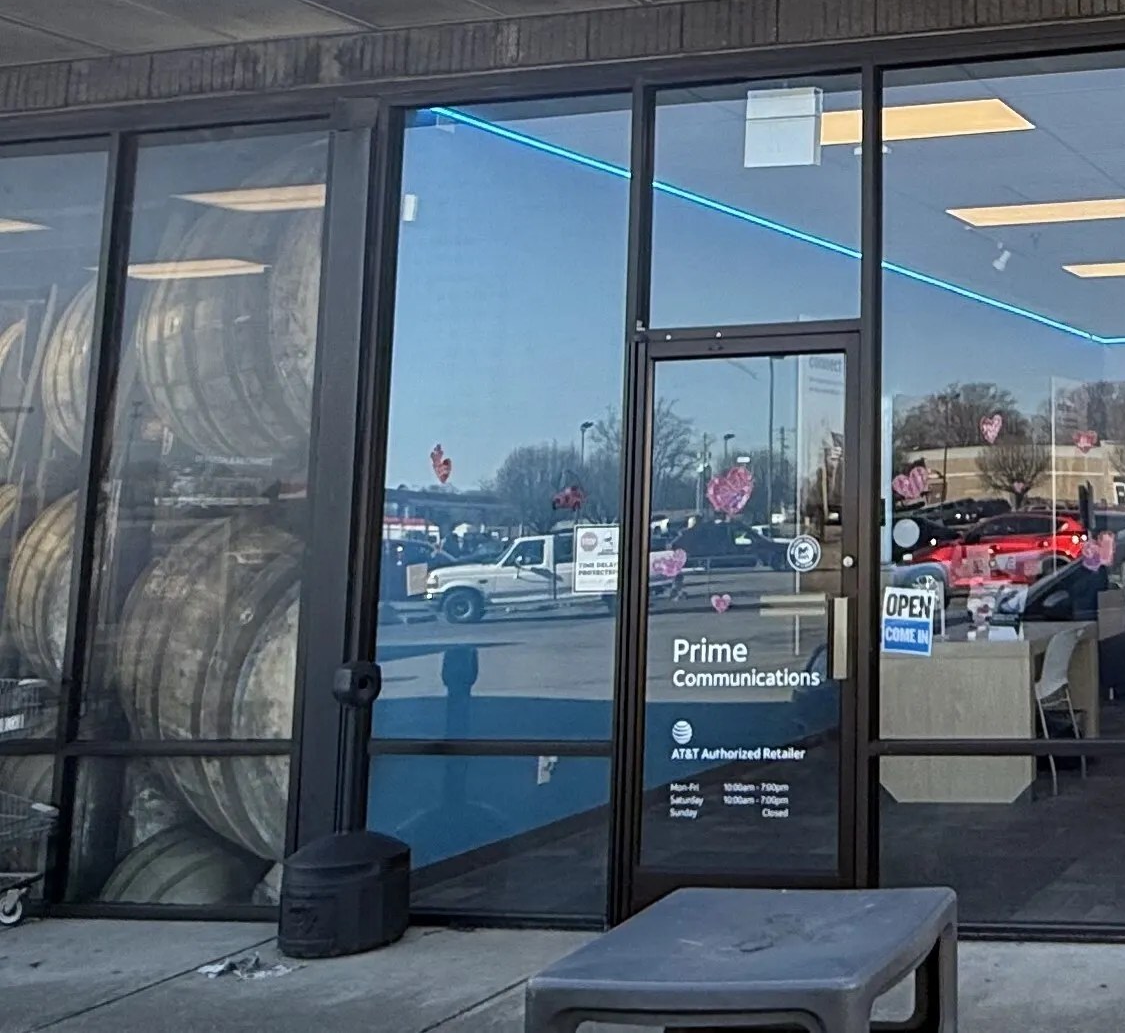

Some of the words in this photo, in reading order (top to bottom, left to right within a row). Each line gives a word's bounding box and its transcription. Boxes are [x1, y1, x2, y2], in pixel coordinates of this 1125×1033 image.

[886, 593, 932, 619] OPEN
[885, 626, 916, 644] COME
[917, 628, 929, 645] IN
[673, 637, 748, 663] Prime
[673, 668, 820, 687] Communications
[671, 748, 700, 760] AT&T
[701, 747, 761, 760] Authorized
[763, 747, 806, 760] Retailer
[670, 795, 704, 806] Saturday
[669, 808, 698, 819] Sunday
[761, 808, 789, 818] Closed
